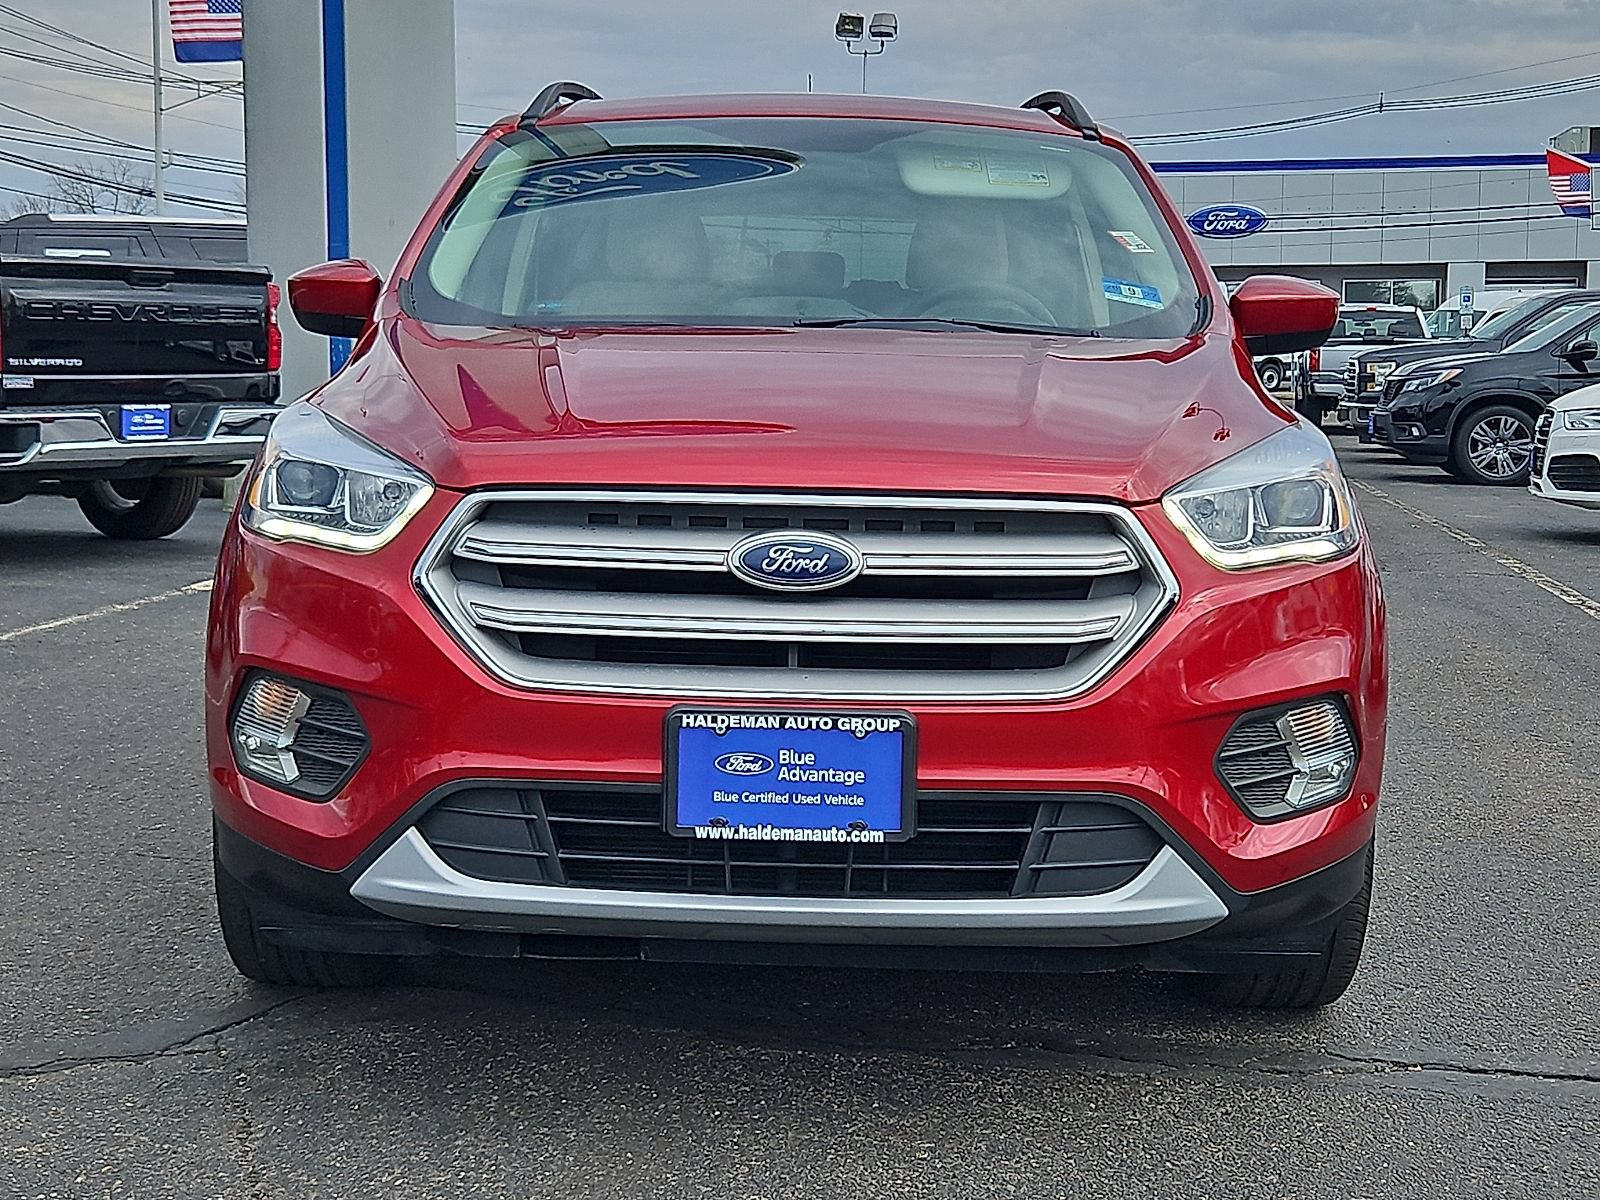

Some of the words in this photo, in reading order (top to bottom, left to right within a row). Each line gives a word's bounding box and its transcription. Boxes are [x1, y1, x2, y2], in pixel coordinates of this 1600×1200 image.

[1203, 211, 1250, 230] Ford
[1127, 287, 1136, 296] 9
[26, 302, 260, 324] CHEVROLET
[8, 357, 83, 366] SILVERADO
[761, 545, 830, 574] Ford
[681, 714, 780, 729] HALDEMAN
[784, 716, 833, 730] AUTO
[837, 718, 901, 732] GROUP
[725, 755, 763, 772] Ford
[779, 749, 815, 765] Blue
[777, 766, 865, 785] Advantage
[713, 791, 739, 802] Blue
[741, 791, 789, 804] Certified
[792, 793, 821, 805] Used
[824, 794, 865, 806] Vehicle
[694, 824, 884, 843] www.haldemanauto.com
